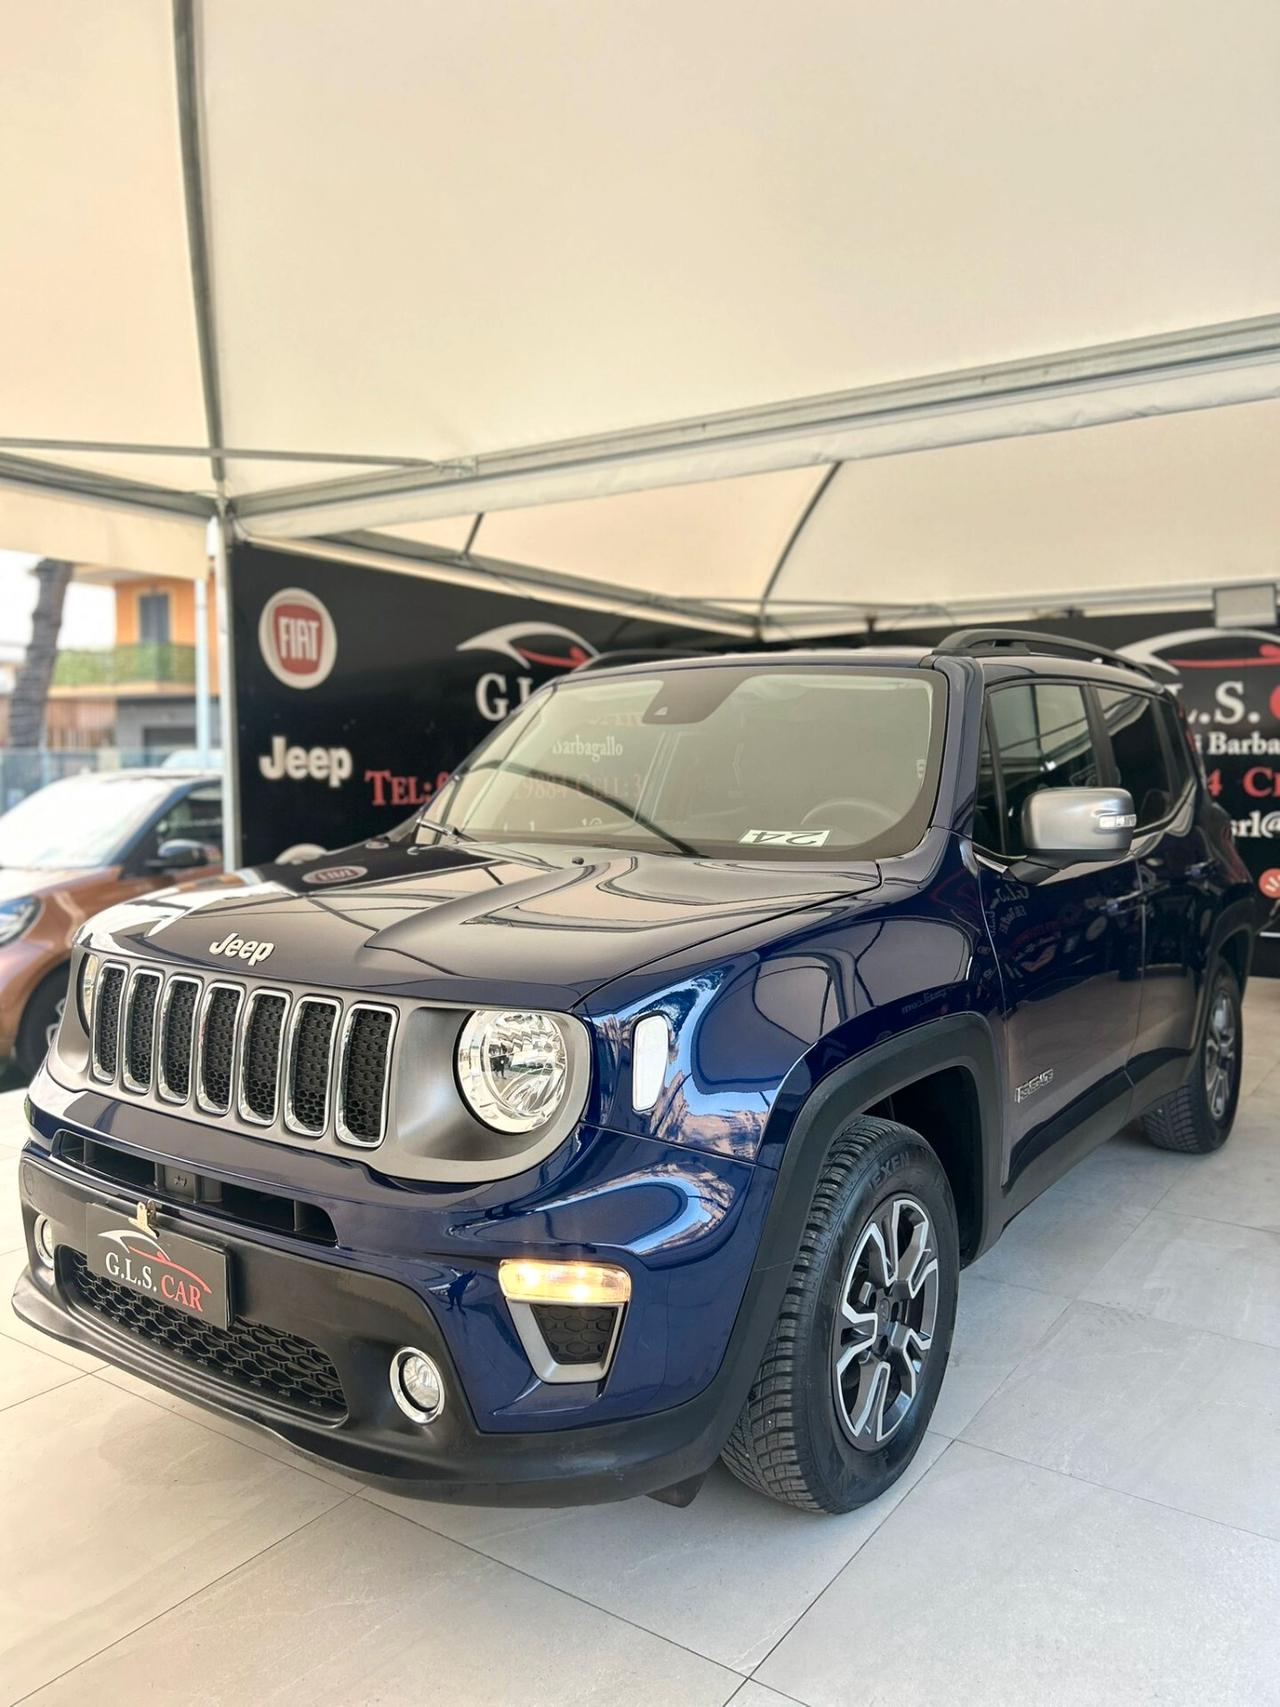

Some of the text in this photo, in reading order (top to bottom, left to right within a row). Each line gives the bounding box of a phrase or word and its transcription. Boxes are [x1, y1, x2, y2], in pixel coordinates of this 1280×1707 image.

[278, 614, 321, 662] FIAT
[259, 735, 353, 787] Jeep
[209, 932, 276, 966] Jeep
[105, 1252, 204, 1313] G.L.S. CAR
